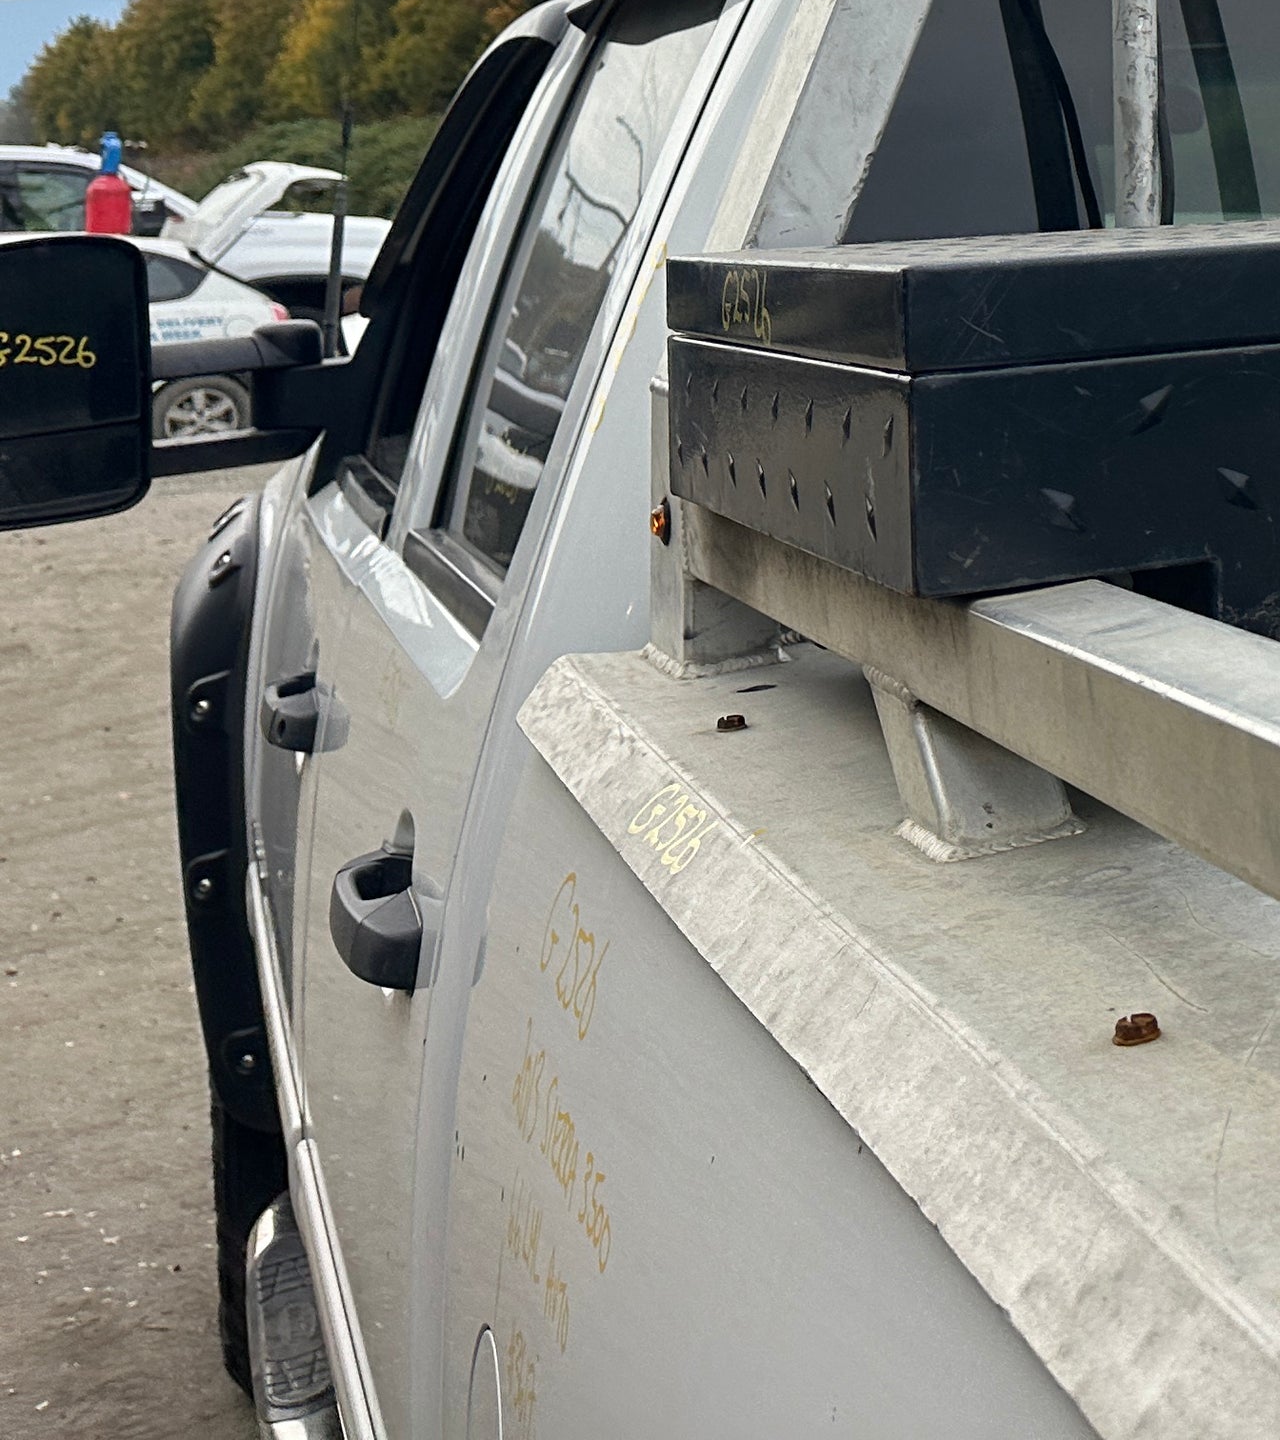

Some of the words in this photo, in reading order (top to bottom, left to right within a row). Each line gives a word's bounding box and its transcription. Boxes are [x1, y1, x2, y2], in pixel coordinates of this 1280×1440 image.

[627, 783, 719, 875] G2526
[541, 871, 610, 1041] G2526
[577, 1151, 611, 1274] 3500
